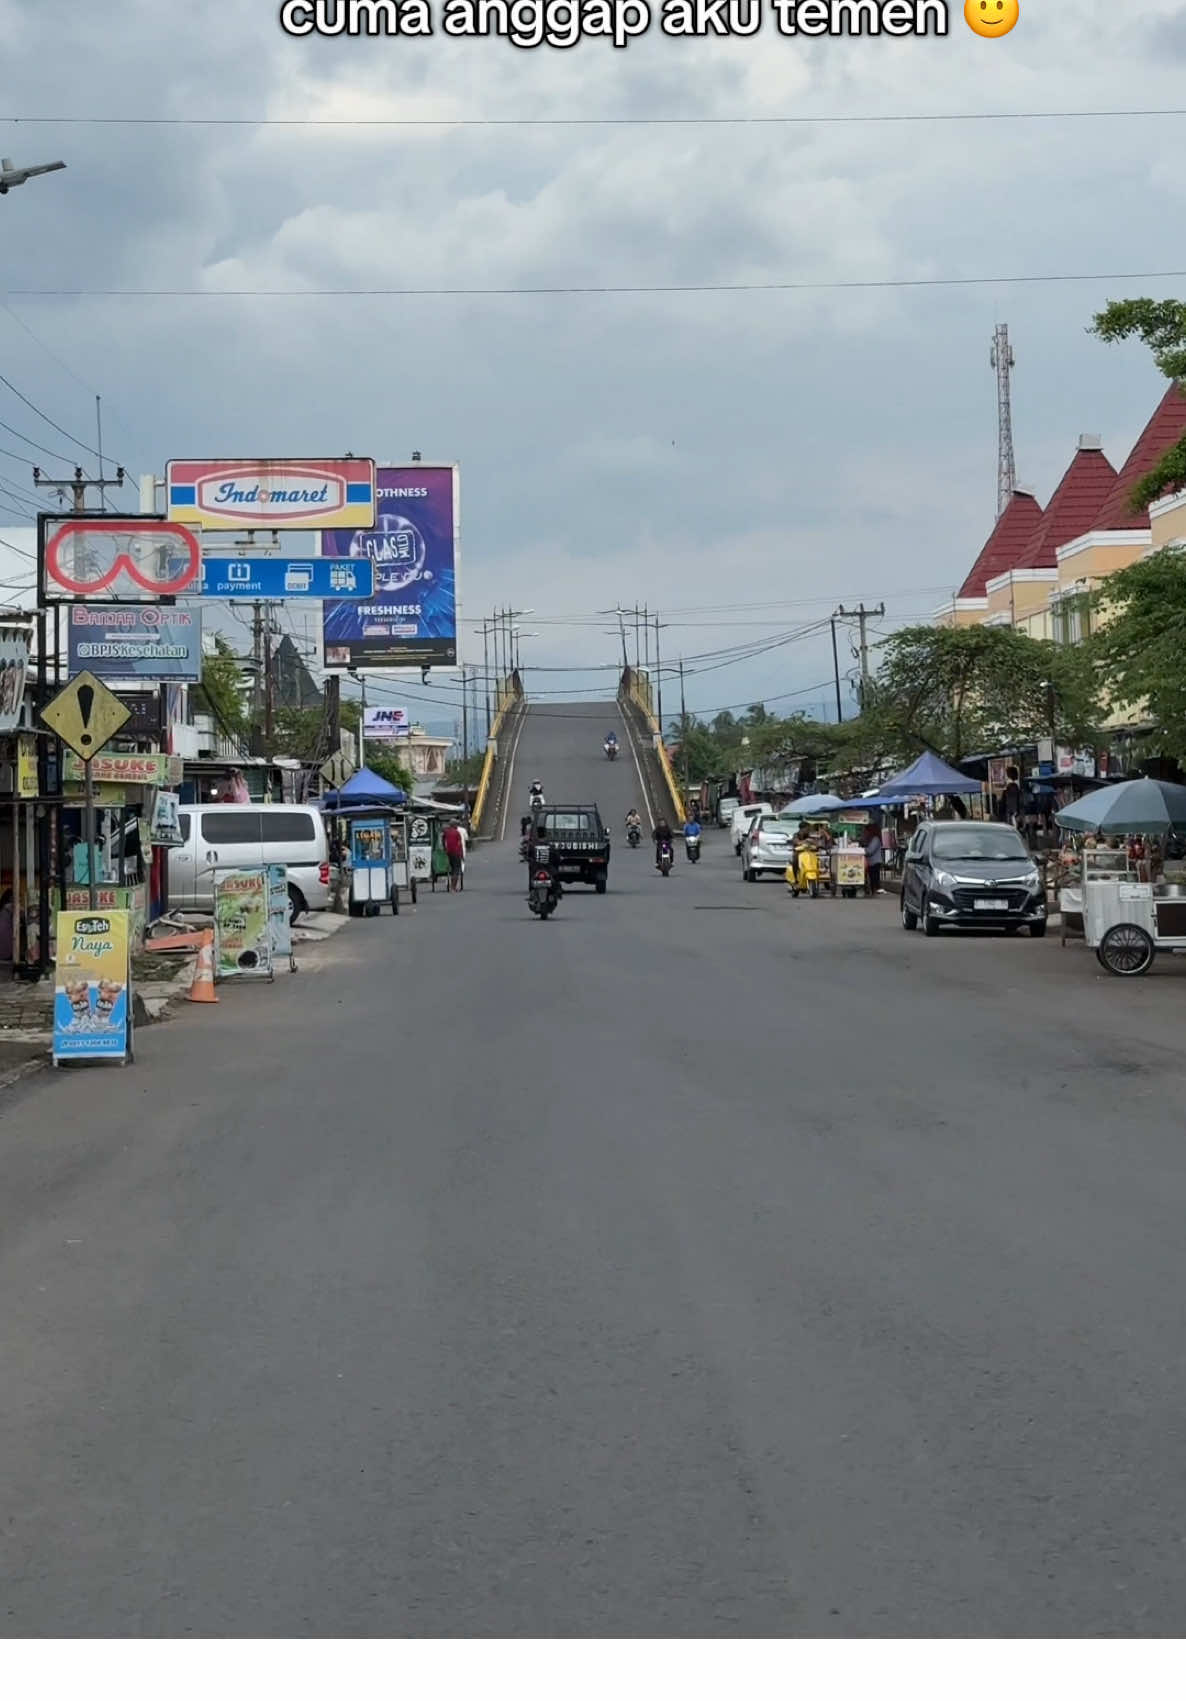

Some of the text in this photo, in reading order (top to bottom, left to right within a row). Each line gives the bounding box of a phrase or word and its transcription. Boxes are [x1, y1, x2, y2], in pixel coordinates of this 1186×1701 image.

[214, 482, 328, 502] Indomaret
[376, 487, 428, 498] OTHNESS
[217, 582, 262, 592] payment
[358, 605, 422, 616] FRESHNESS
[91, 643, 186, 657] BPJS Kesehatan
[372, 710, 404, 722] JNE
[71, 936, 112, 957] Naya
